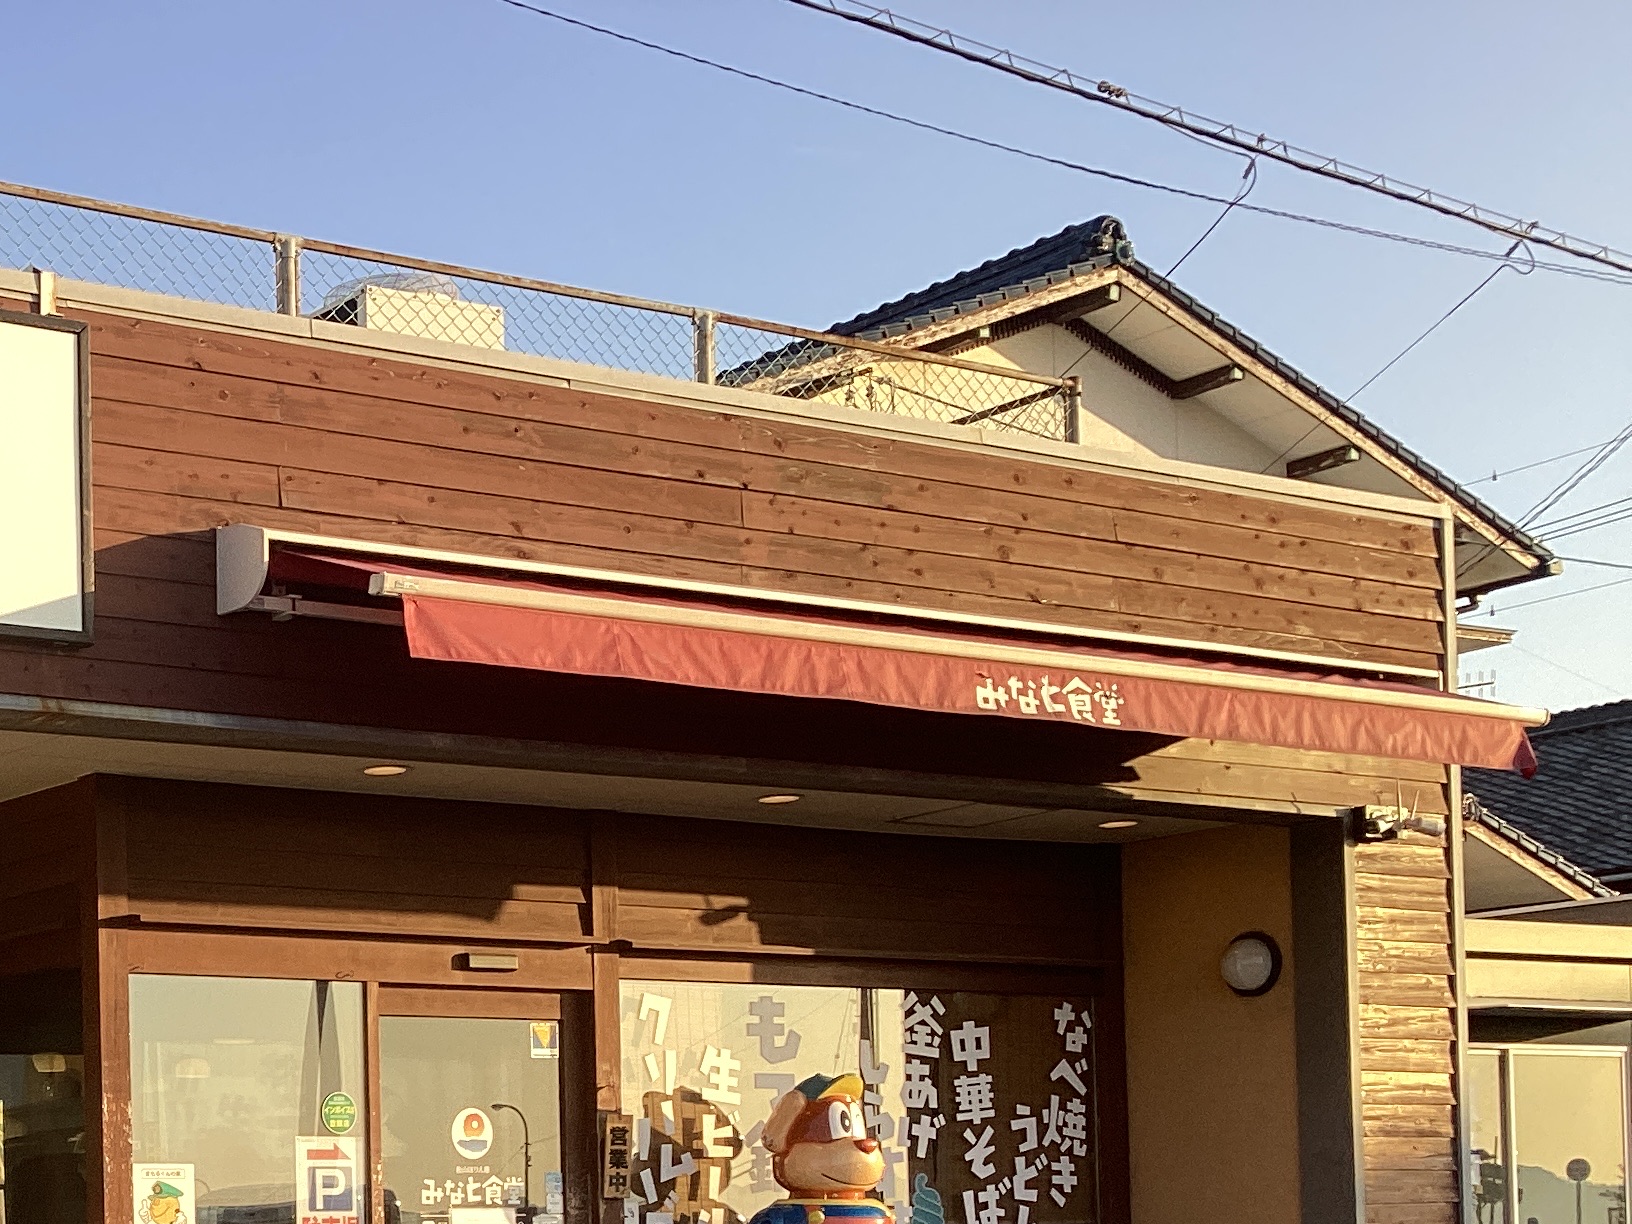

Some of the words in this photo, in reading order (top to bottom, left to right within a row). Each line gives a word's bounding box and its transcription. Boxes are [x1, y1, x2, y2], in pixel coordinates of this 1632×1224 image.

[976, 674, 1125, 726] みなと食堂
[1041, 1002, 1093, 1208] なべ焼き
[609, 1126, 629, 1192] 営業中
[316, 1168, 346, 1209] P
[421, 1174, 525, 1205] みなと食堂
